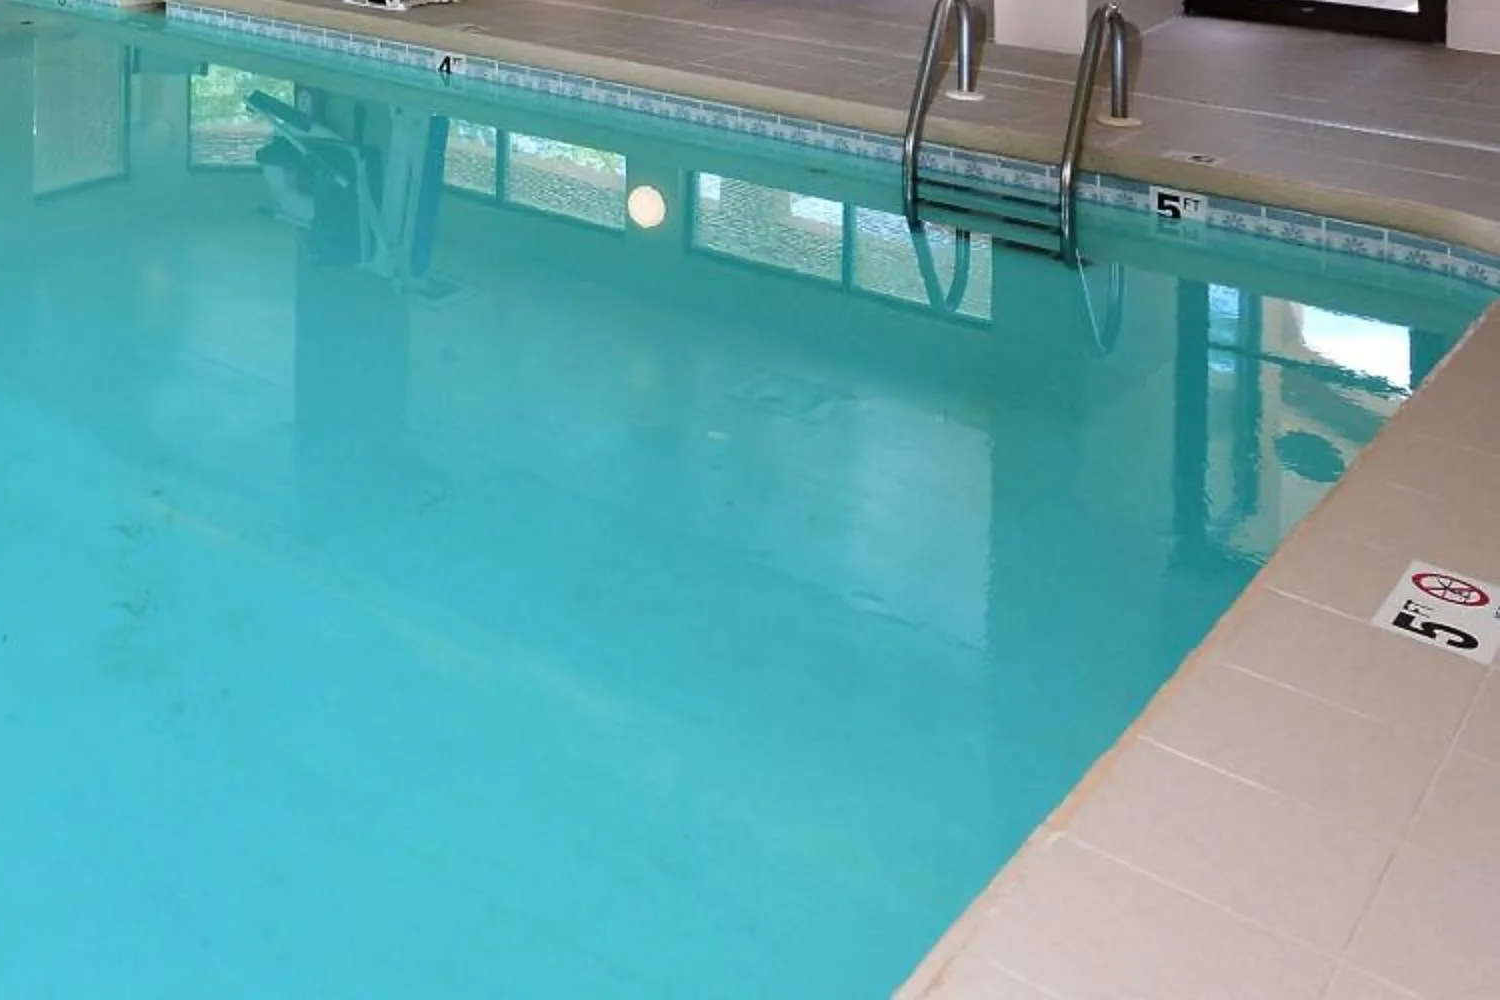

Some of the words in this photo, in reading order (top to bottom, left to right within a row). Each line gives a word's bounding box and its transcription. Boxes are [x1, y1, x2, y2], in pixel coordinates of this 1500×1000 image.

[1156, 192, 1182, 219] 5
[1184, 197, 1201, 213] FT
[1403, 599, 1434, 619] FT
[1392, 610, 1480, 650] 5
